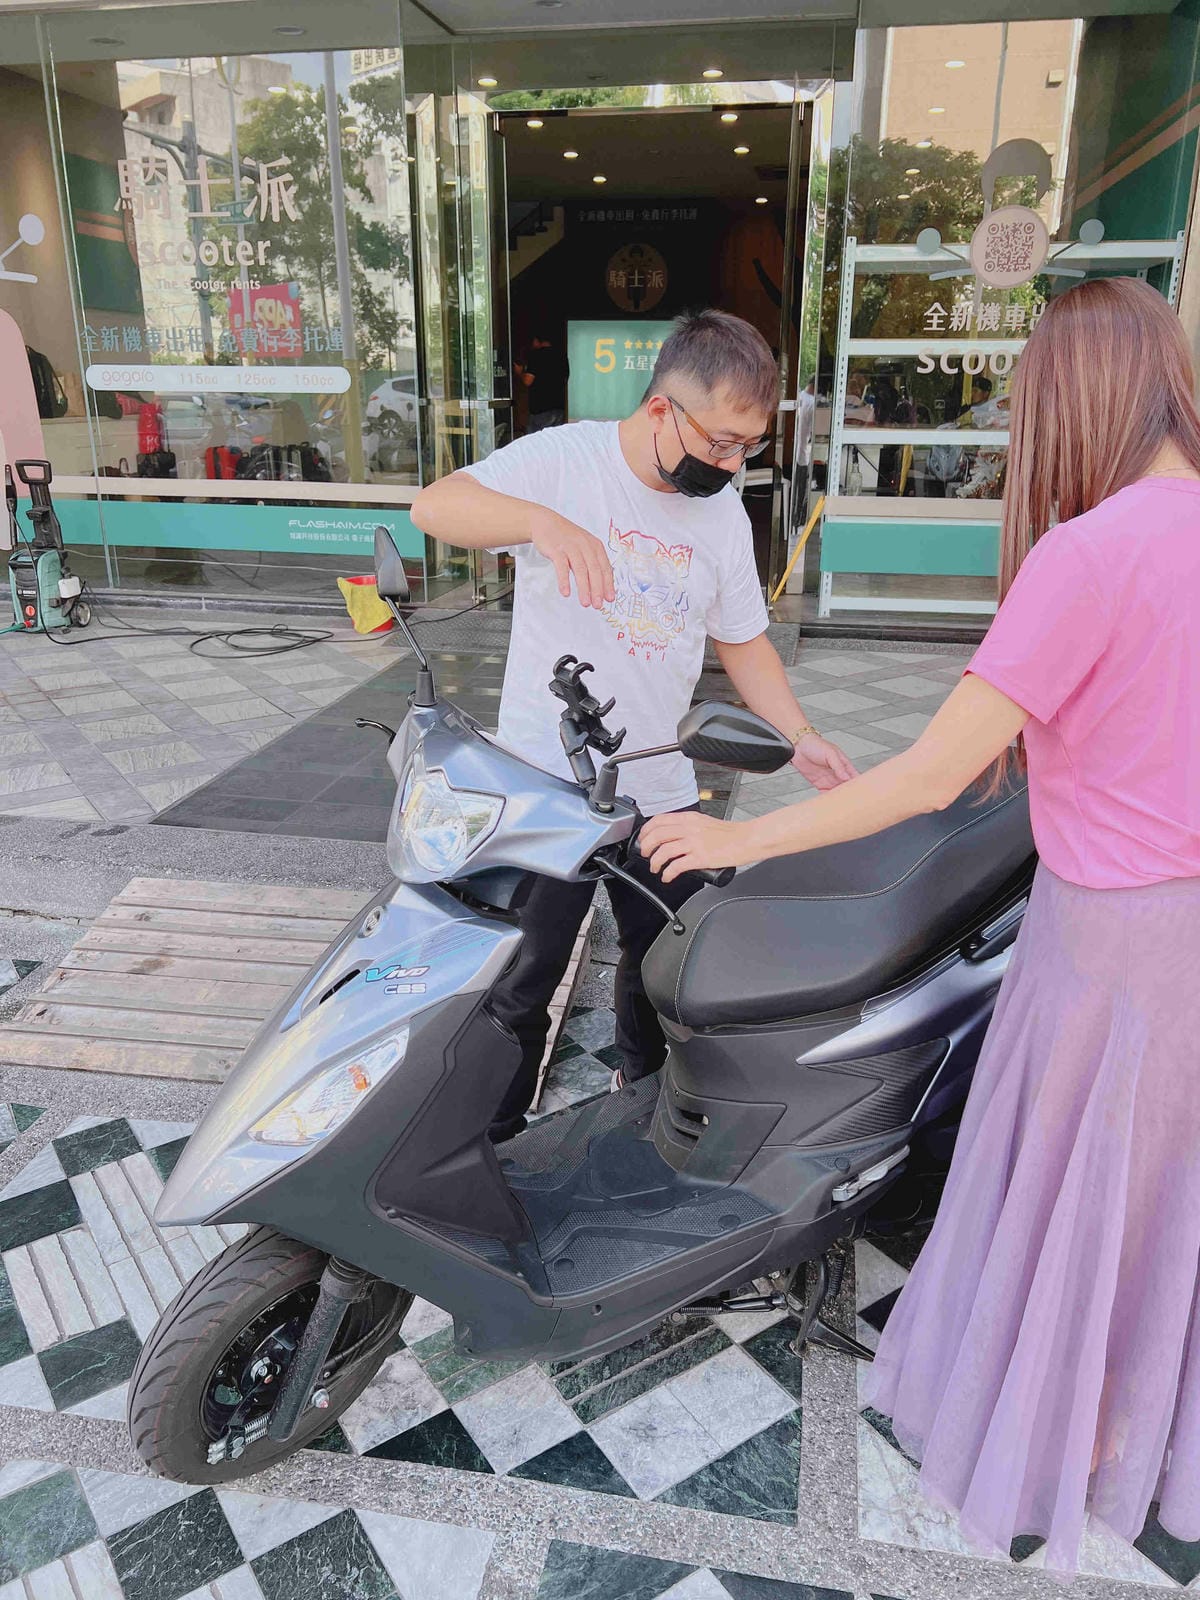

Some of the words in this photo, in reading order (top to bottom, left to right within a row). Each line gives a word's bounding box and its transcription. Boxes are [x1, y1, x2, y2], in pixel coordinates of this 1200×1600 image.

[114, 156, 297, 222] 騎士派
[140, 238, 271, 267] scooter
[231, 279, 261, 290] rents
[608, 269, 664, 288] 騎士派
[80, 325, 204, 353] 全新機車出租
[220, 325, 345, 353] 免費行李托運
[595, 339, 616, 373] 5
[916, 346, 1020, 376] scoo
